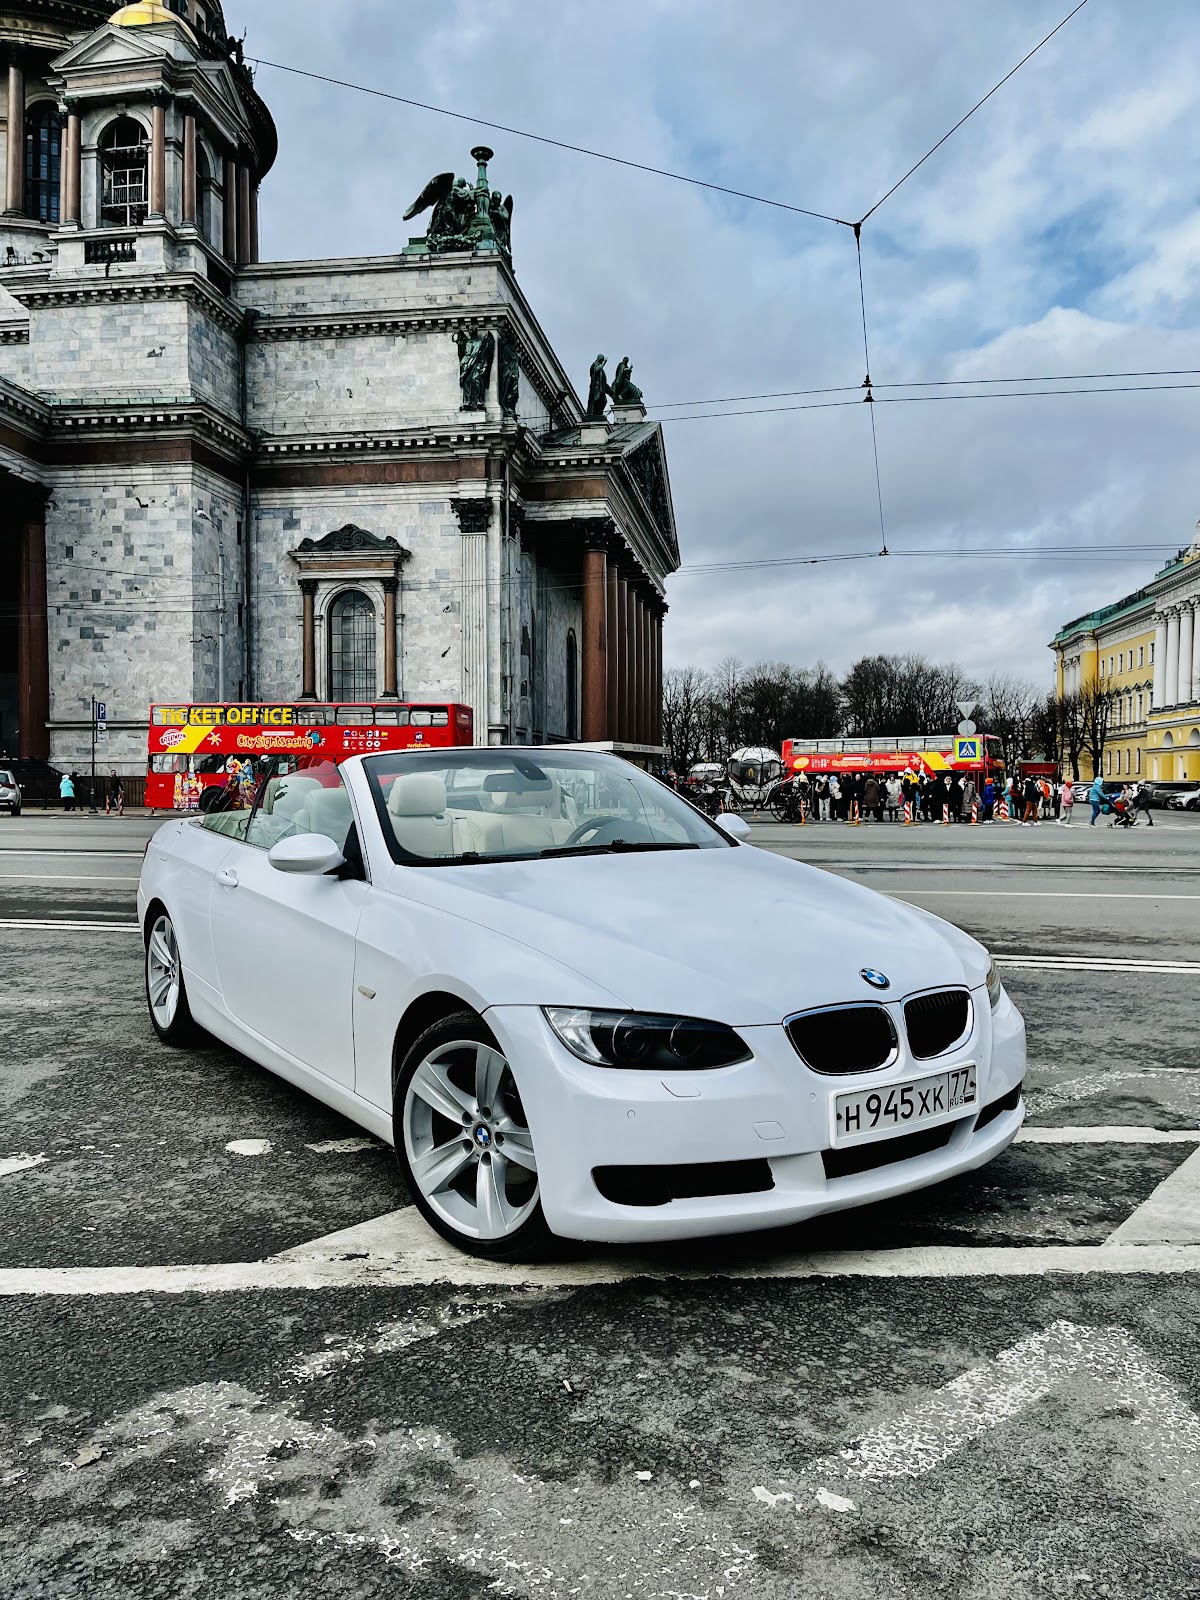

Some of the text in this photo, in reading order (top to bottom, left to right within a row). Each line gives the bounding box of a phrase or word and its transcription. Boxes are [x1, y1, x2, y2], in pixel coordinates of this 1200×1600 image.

[226, 707, 293, 725] OFFICE
[951, 1070, 970, 1098] 77
[950, 1095, 964, 1108] RUS
